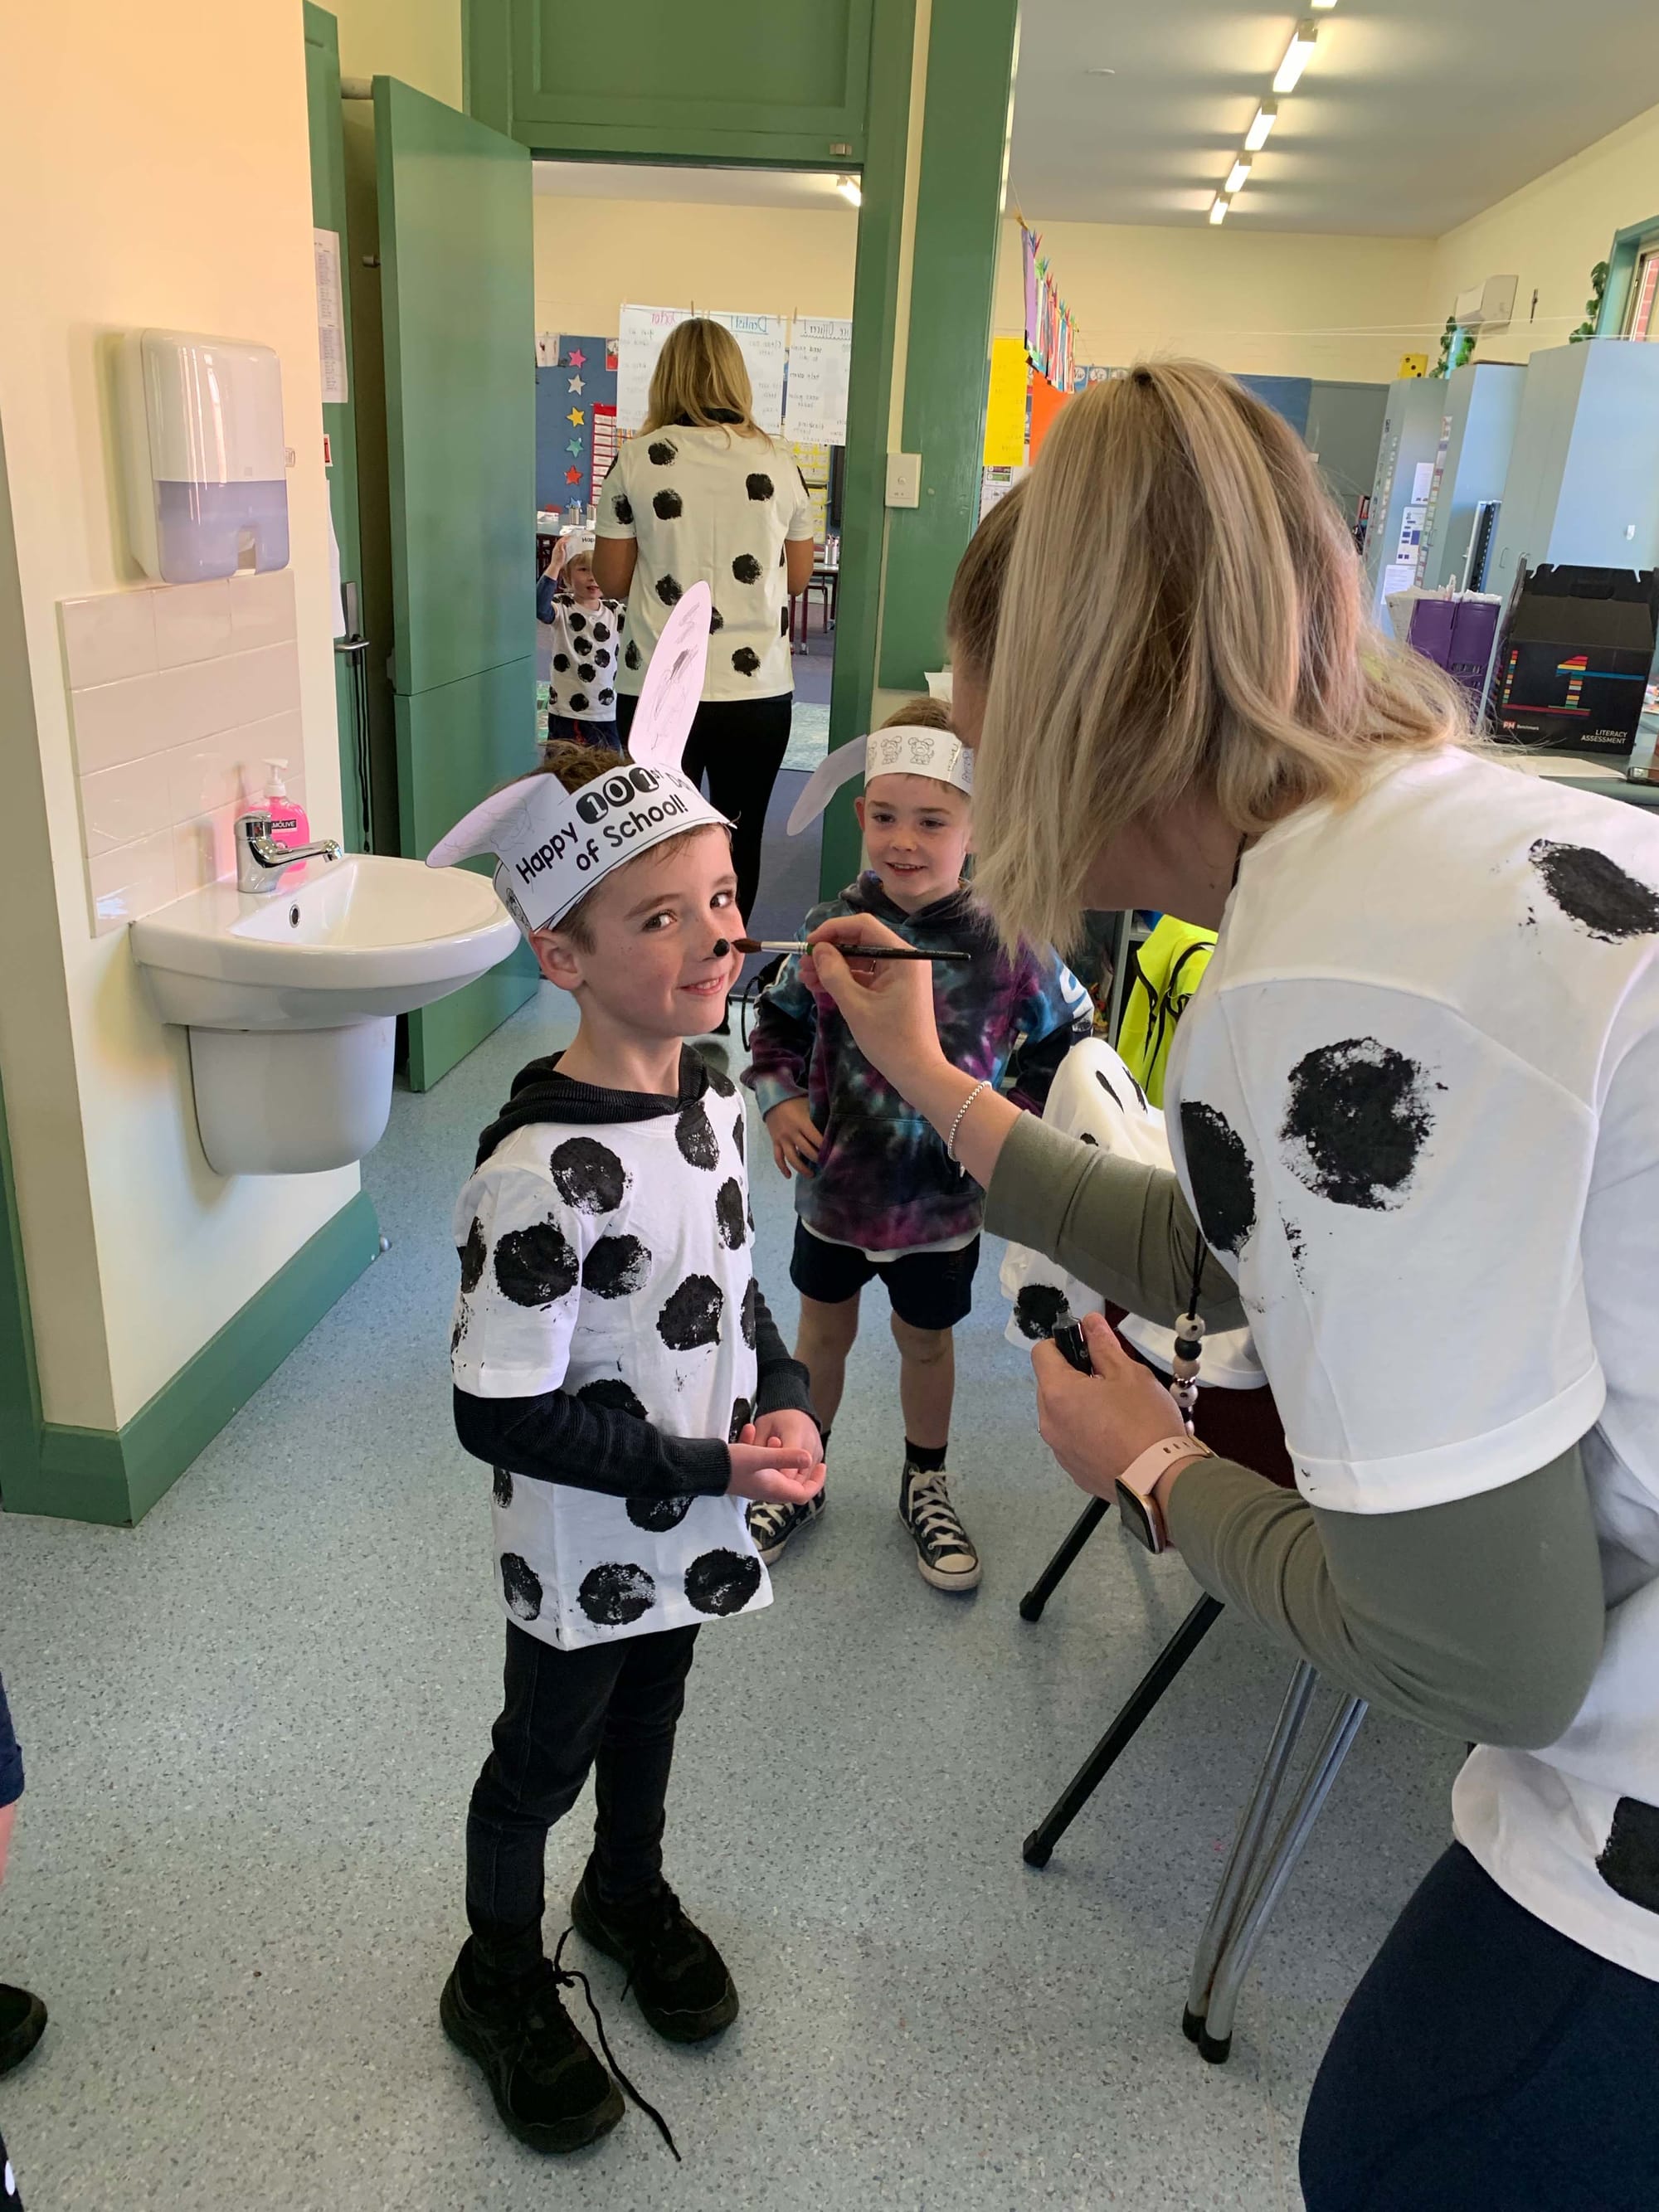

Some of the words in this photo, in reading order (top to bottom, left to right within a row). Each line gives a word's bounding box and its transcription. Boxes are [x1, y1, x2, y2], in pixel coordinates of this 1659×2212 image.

[1503, 721, 1515, 729] PM
[1595, 729, 1627, 737] LITERACY
[1580, 735, 1626, 744] ASSESSMENT
[576, 838, 599, 871] of
[602, 793, 688, 848] School!
[515, 821, 578, 884] Happy
